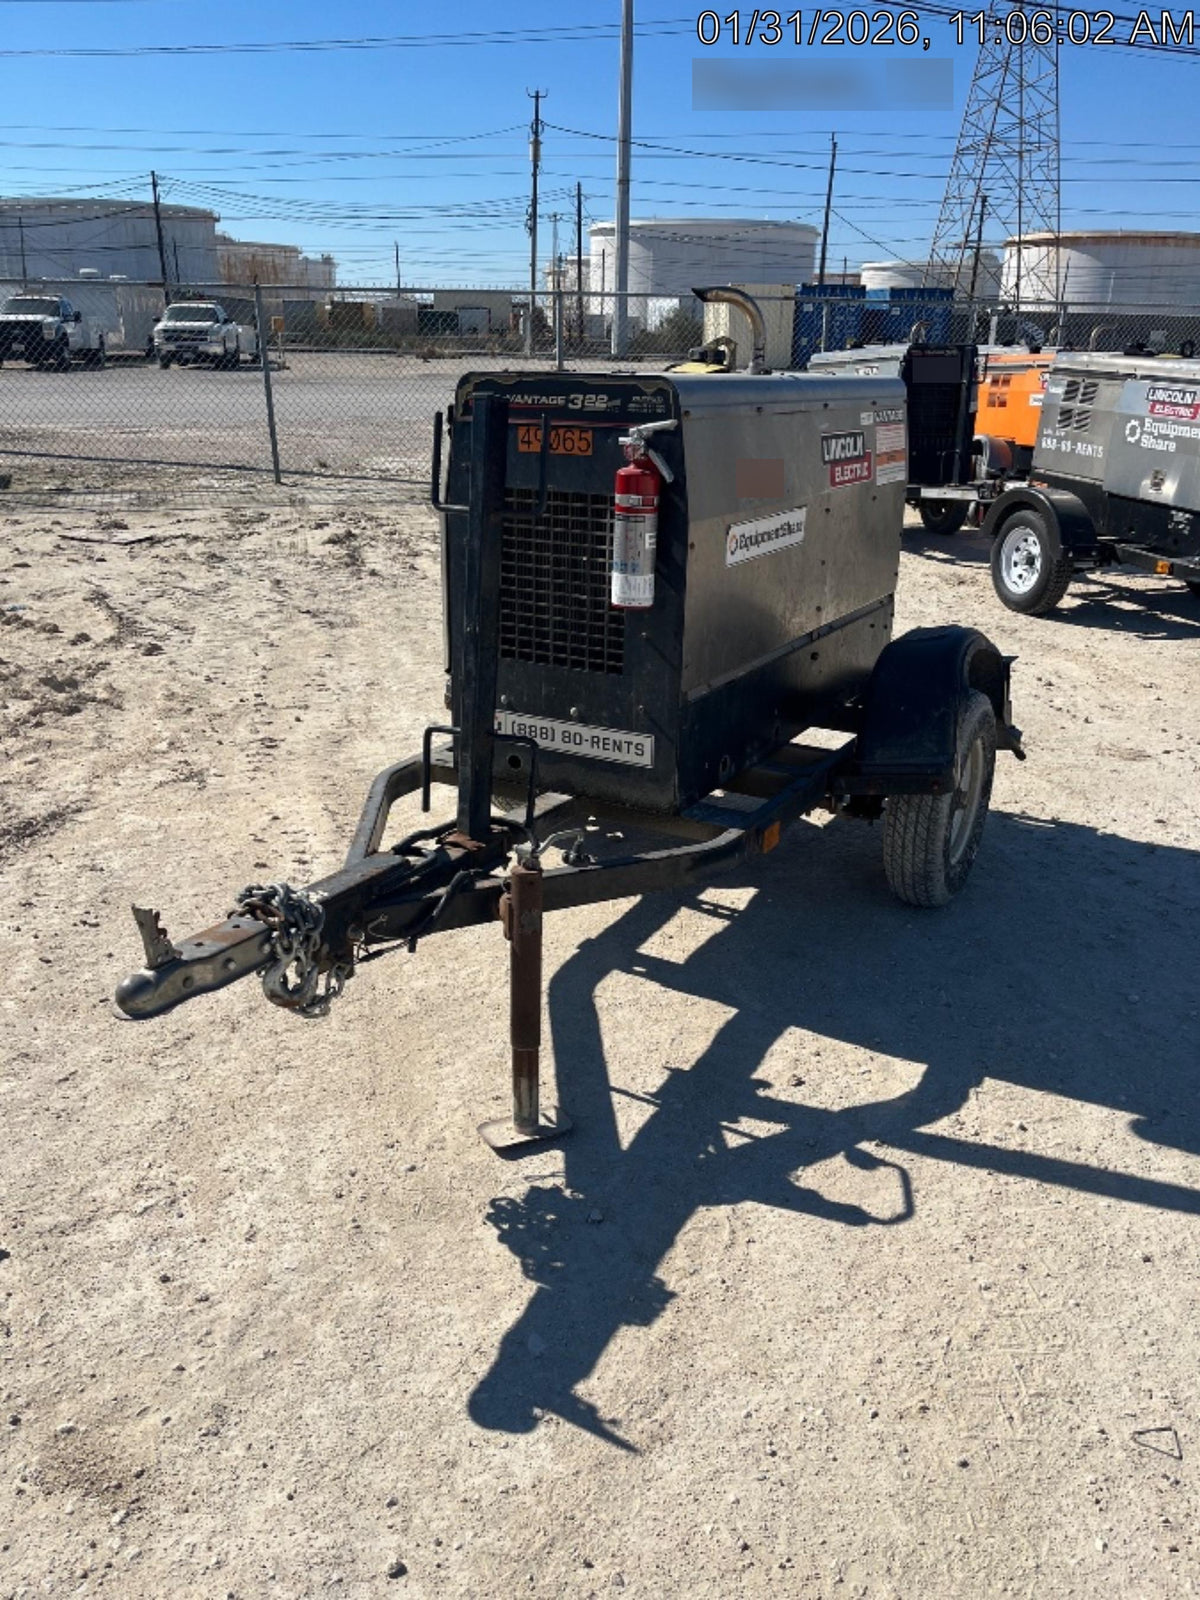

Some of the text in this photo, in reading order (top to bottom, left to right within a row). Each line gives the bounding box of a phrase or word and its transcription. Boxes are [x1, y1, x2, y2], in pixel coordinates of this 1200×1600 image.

[567, 393, 609, 410] 322
[1148, 387, 1195, 405] LINCOLN
[1153, 404, 1195, 417] ELECTRIC
[822, 434, 864, 462] LINCOLN
[1140, 432, 1177, 453] Share
[834, 461, 869, 483] ELECTRIC
[511, 719, 557, 742] (888)
[561, 729, 646, 758] 80-RENTS
